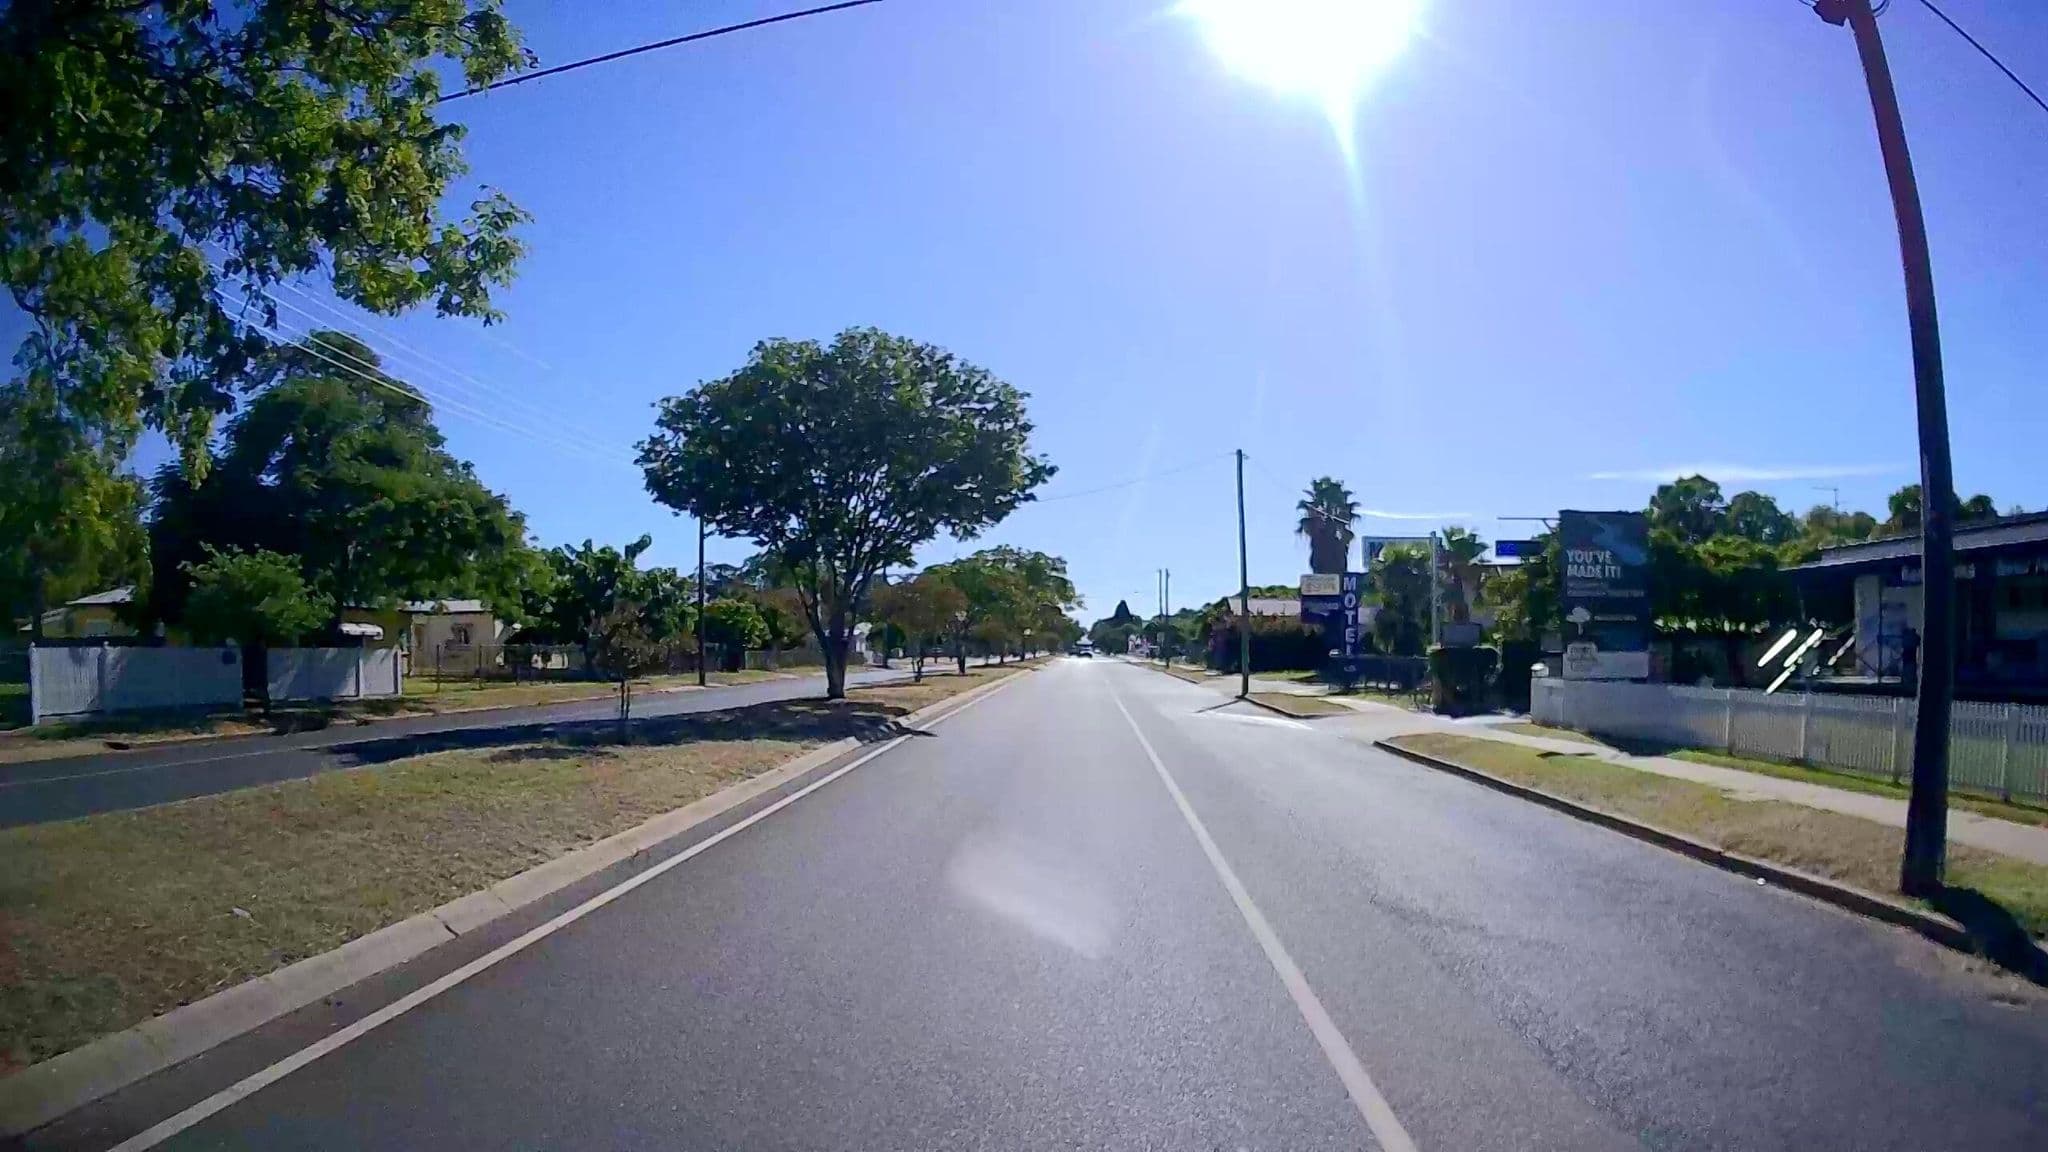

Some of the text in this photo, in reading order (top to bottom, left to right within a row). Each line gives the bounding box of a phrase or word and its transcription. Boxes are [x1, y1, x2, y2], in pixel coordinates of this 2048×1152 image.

[1566, 550, 1613, 564] YOU'VE
[1567, 564, 1621, 578] MADE IT!
[1343, 576, 1357, 657] MOTEL
